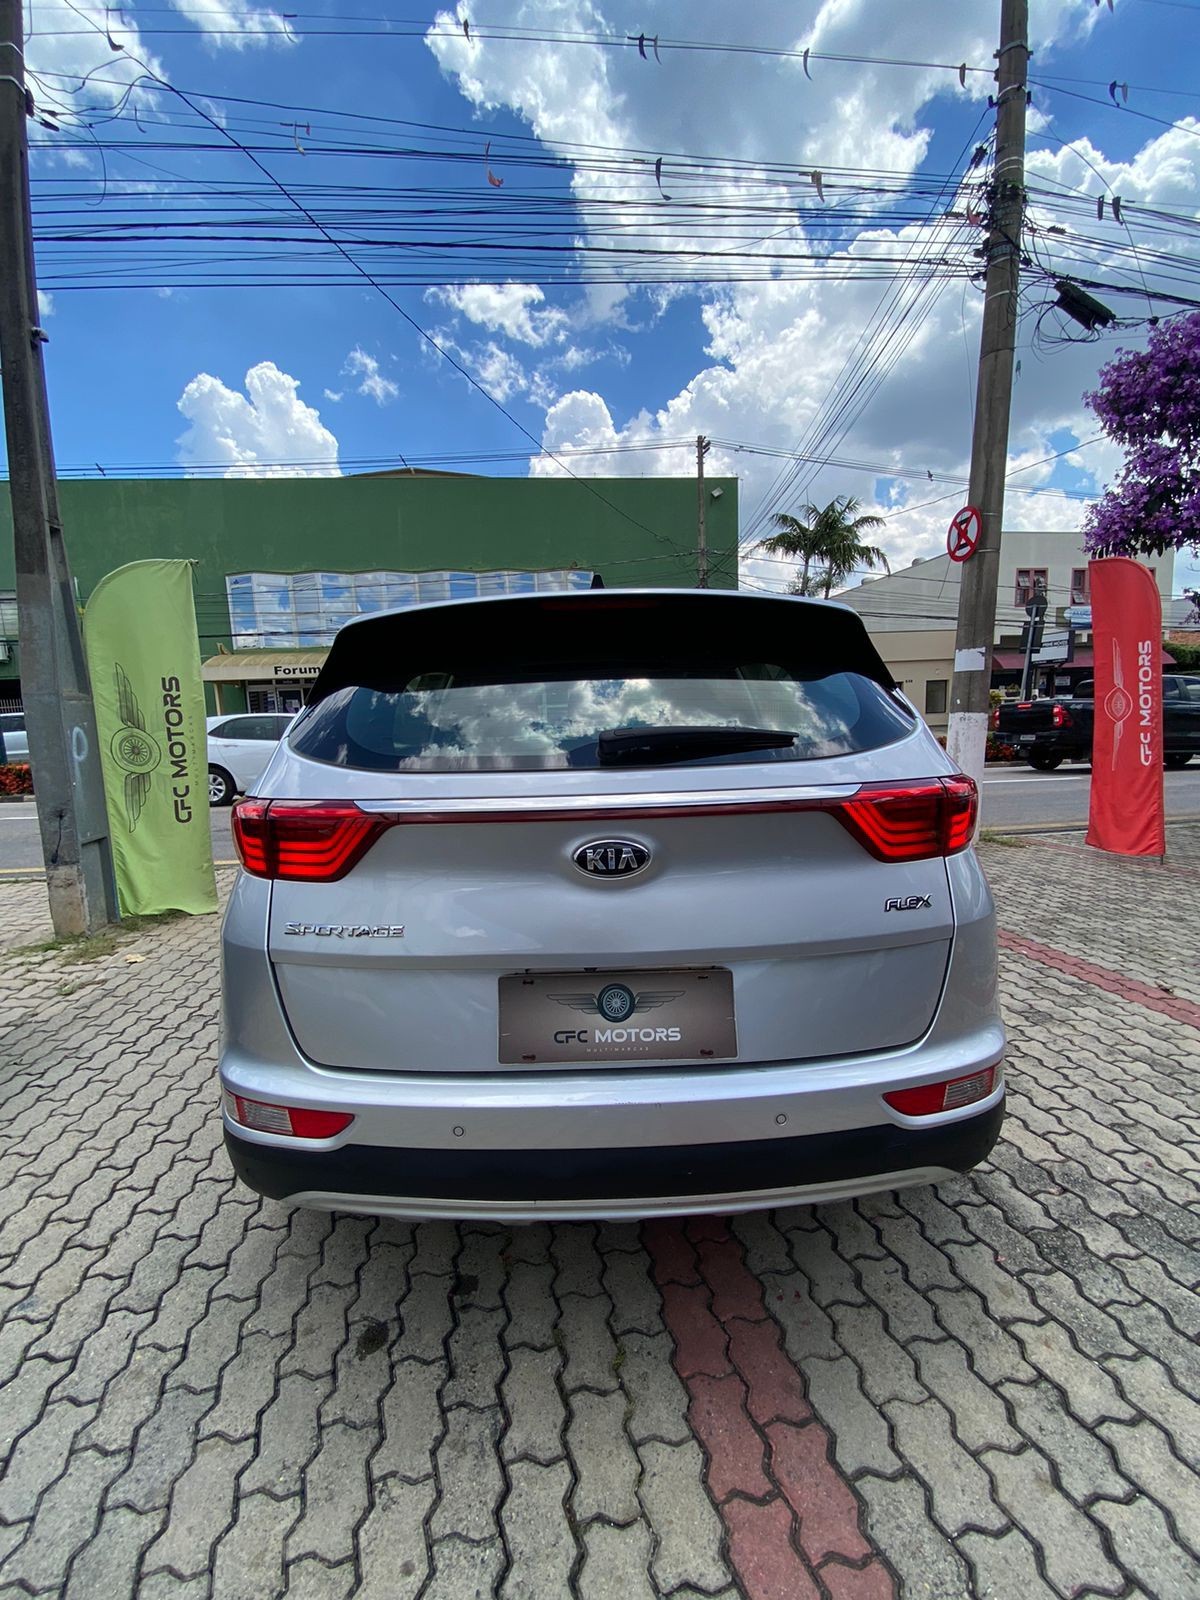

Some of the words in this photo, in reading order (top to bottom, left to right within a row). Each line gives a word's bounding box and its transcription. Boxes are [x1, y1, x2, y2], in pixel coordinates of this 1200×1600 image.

[273, 666, 322, 675] Forum
[1138, 640, 1152, 726] MOTORS
[161, 676, 188, 778] MOTORS
[1140, 732, 1152, 766] CFC
[173, 785, 192, 823] CFC
[586, 847, 639, 870] KIA
[884, 893, 932, 912] FLEX
[284, 922, 405, 939] SPORTAGE
[553, 1029, 588, 1044] CFC
[595, 1027, 682, 1043] MOTORS
